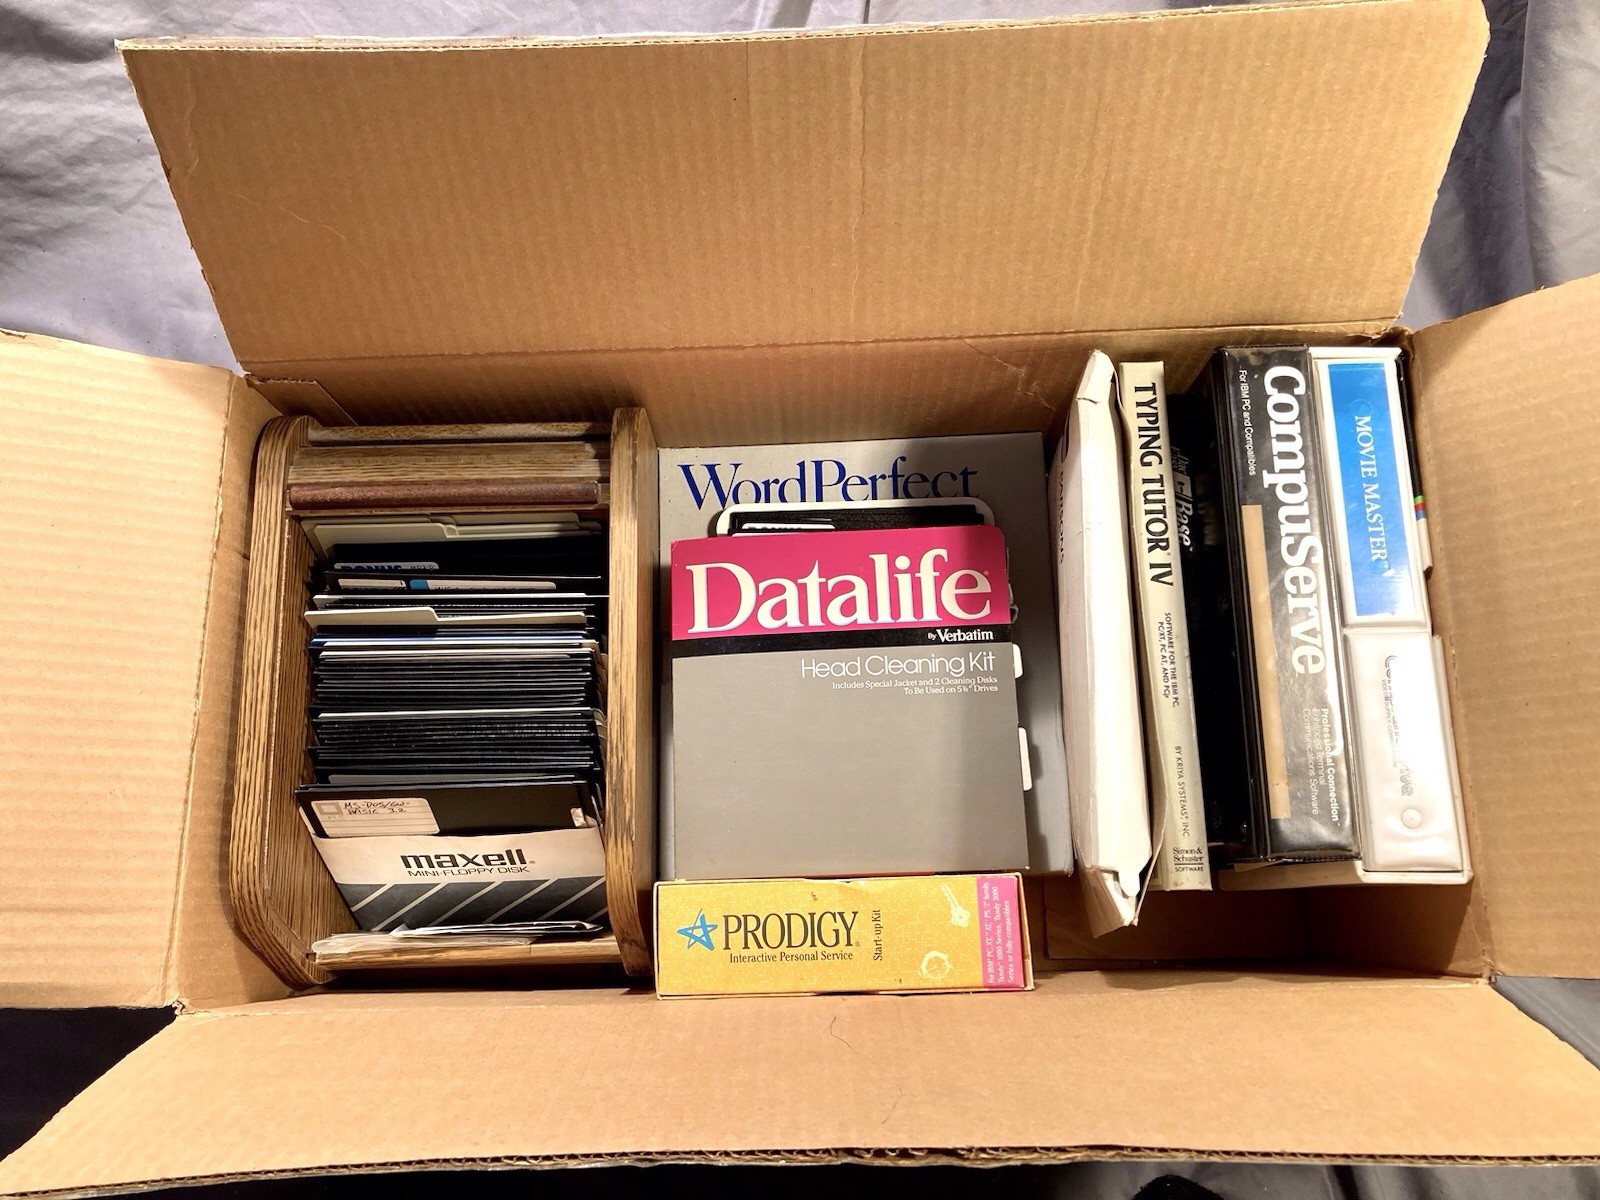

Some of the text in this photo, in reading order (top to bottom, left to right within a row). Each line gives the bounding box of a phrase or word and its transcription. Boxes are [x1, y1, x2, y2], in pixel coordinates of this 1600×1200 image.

[1239, 370, 1257, 476] For IBM PC and Compatibles
[677, 456, 980, 510] WordPerfect
[1134, 382, 1174, 587] TYPING TUTOR IV
[1354, 415, 1388, 562] MOVIE MASTER
[1263, 366, 1326, 674] CompuServe
[685, 548, 992, 634] Datalife
[928, 629, 994, 643] By Verbatim
[1164, 612, 1175, 649] SOFTWARE
[1160, 643, 1167, 653] PC
[1168, 650, 1176, 665] FOR
[801, 651, 996, 678] Head Cleaning Kit
[1162, 667, 1170, 684] AND
[832, 676, 998, 690] Includes Special Jacket and 2 Cleaning Disks
[904, 687, 914, 696] To
[914, 687, 924, 695] Be
[925, 686, 945, 694] Used
[974, 684, 998, 693] Drives
[1171, 681, 1179, 695] IBM
[1174, 745, 1183, 755] BY
[1303, 709, 1319, 815] Communications Software
[1176, 756, 1185, 779] KRIYA
[1316, 752, 1327, 786] Terminal
[1321, 708, 1339, 821] Professional Connection
[400, 849, 527, 868] maxell
[408, 866, 530, 876] MINI-FLOPPY DISK
[723, 911, 858, 950] PRODIGY
[872, 910, 884, 961] Start-up Kit
[730, 950, 853, 963] Interactive Personal Service
[1007, 964, 1015, 984] Series
